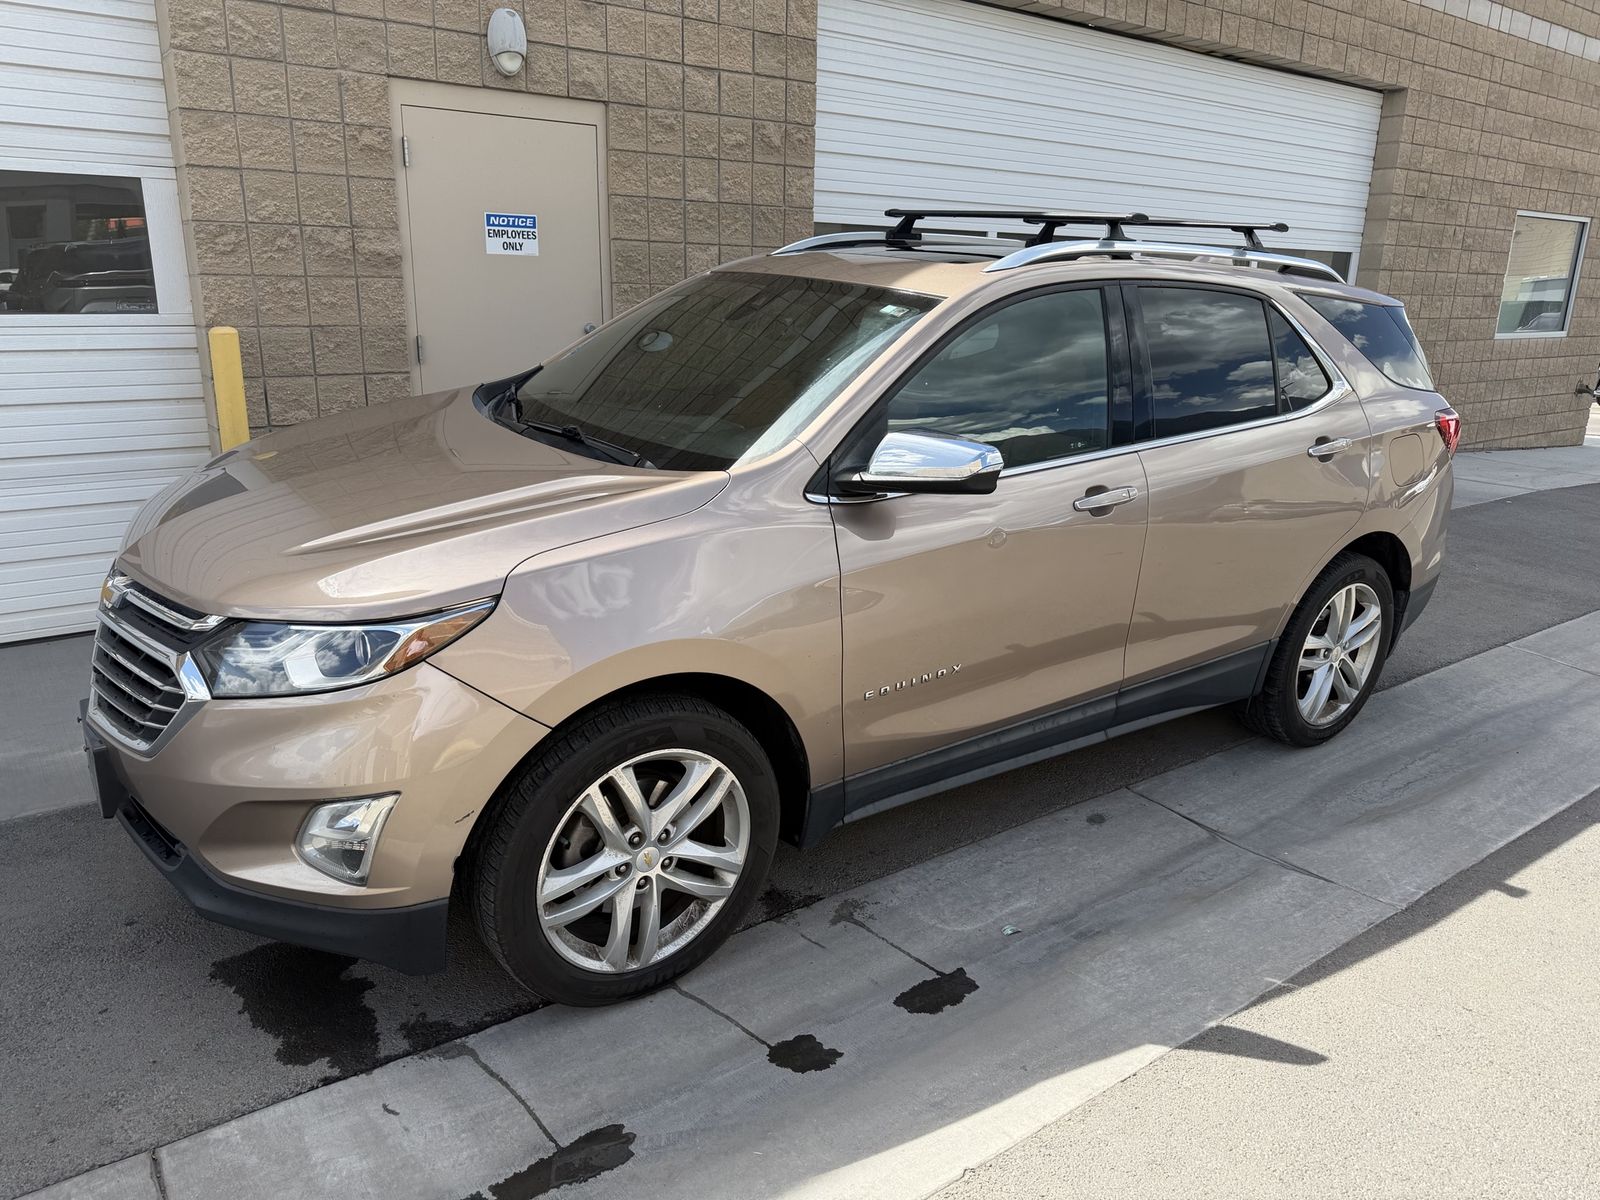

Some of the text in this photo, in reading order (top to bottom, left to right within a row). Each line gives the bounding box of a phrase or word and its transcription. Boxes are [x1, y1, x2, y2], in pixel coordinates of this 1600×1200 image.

[489, 216, 534, 227] NOTICE
[487, 228, 537, 240] EMPLOYEES
[502, 241, 524, 251] ONLY
[864, 663, 962, 701] EQUINOX
